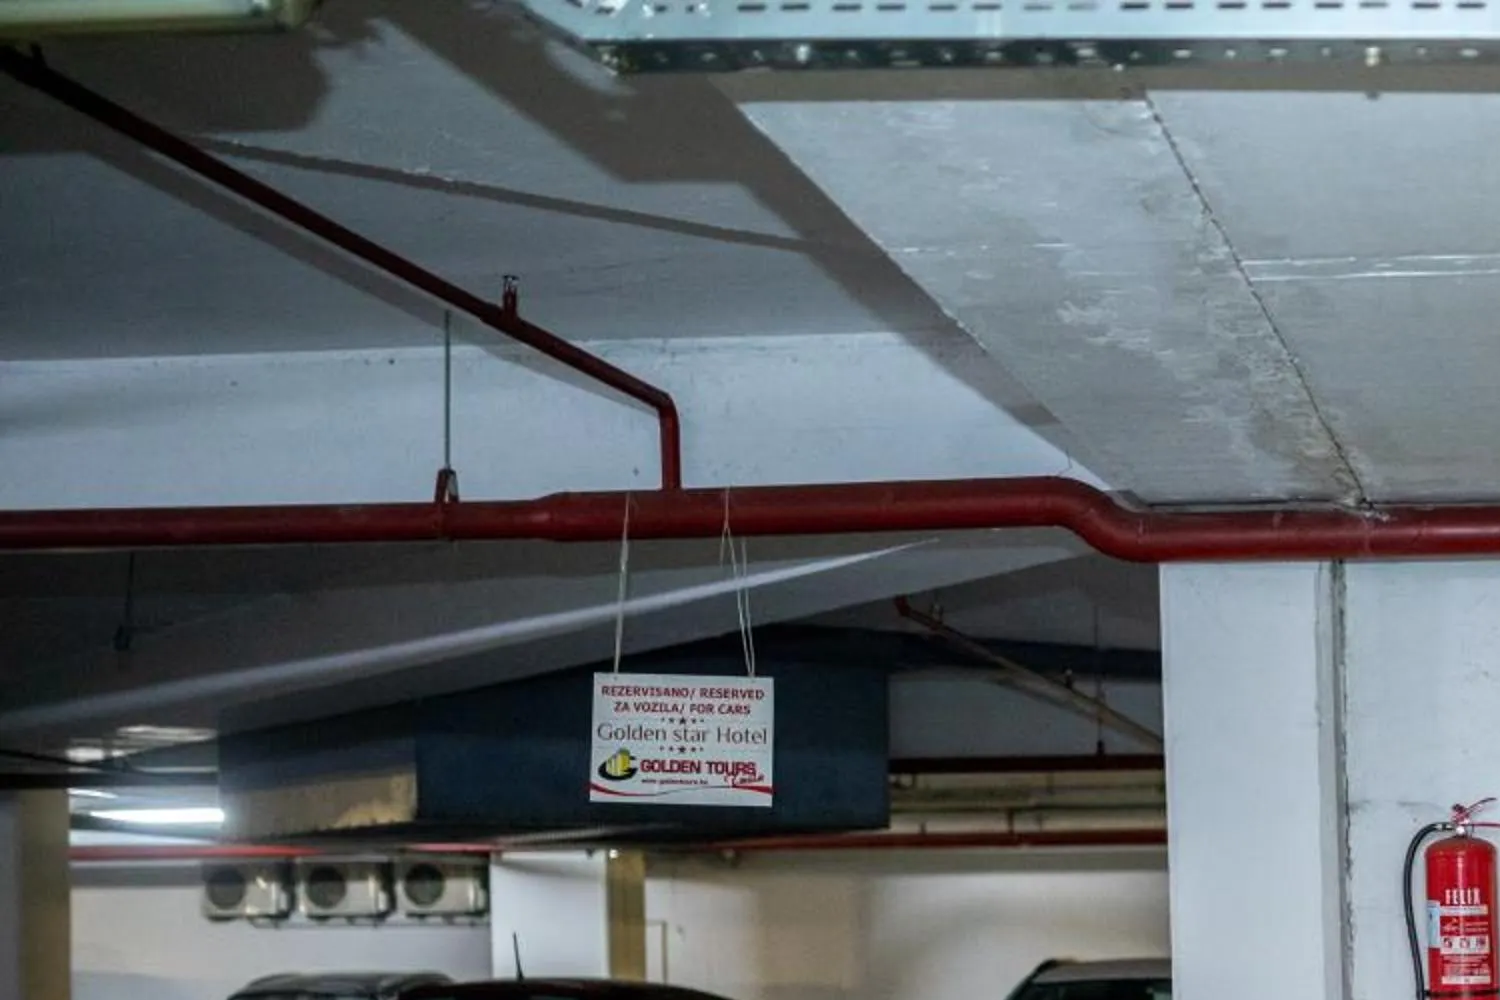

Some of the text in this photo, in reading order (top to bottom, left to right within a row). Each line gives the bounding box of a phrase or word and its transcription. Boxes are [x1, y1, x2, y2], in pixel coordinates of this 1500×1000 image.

[601, 685, 765, 700] REZERVISANO/ RESERVED
[614, 701, 751, 715] ZA VOZILA/ FOR CARS
[597, 722, 768, 744] Golden star Hotel
[640, 759, 757, 776] GOLDEN TOURS
